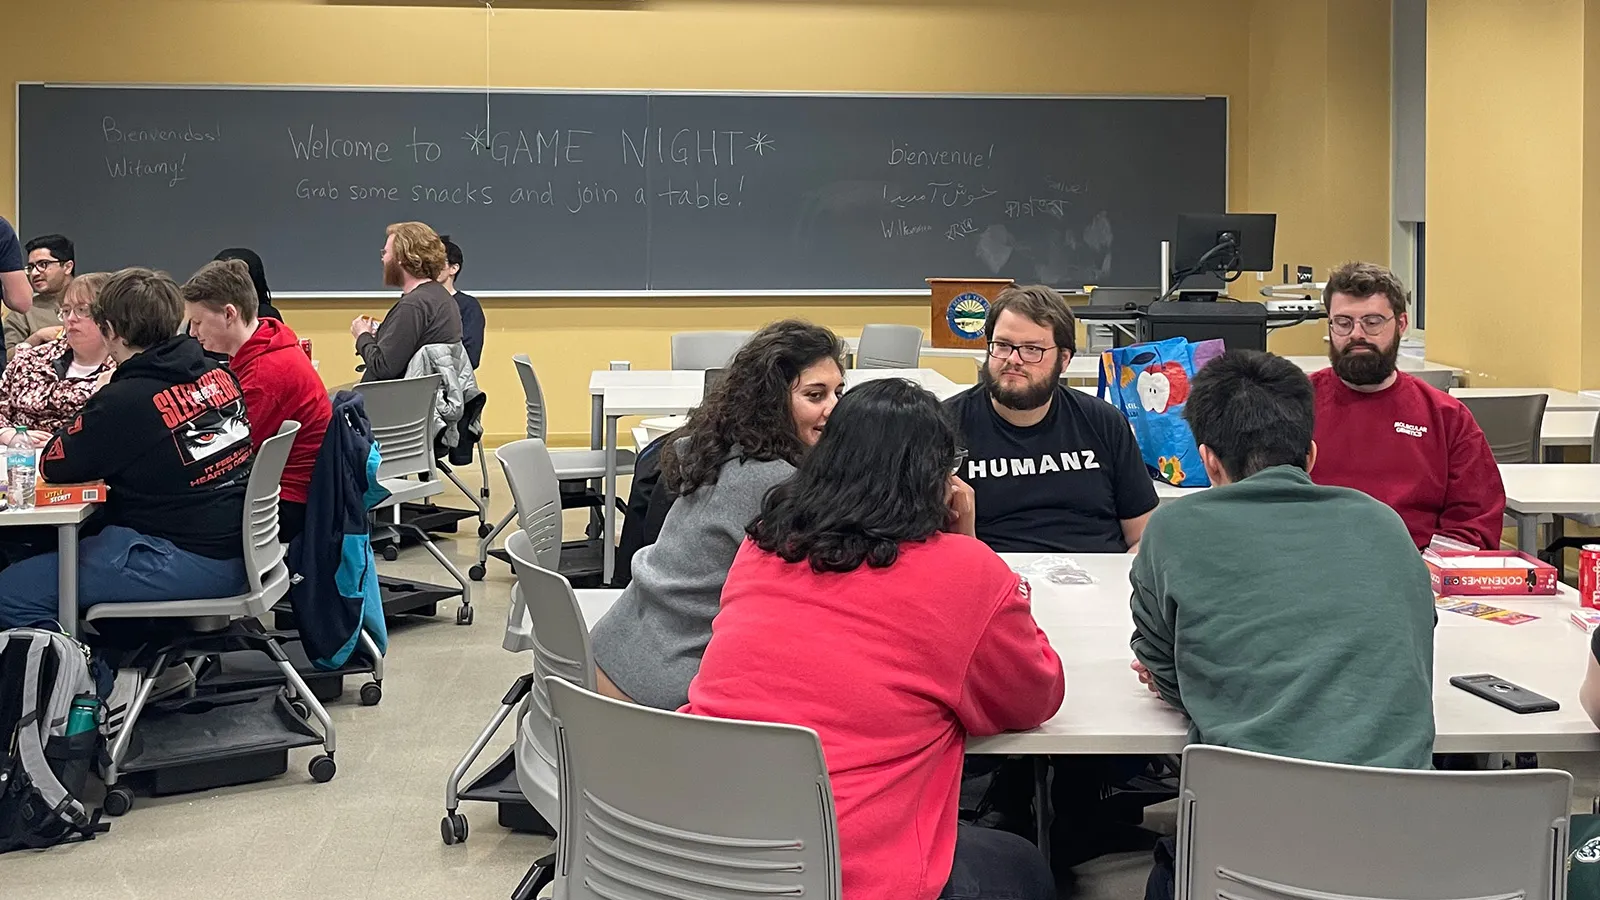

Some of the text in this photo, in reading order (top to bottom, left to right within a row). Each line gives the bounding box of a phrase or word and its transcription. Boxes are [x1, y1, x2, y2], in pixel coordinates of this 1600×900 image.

[102, 115, 221, 142] Bienvenidos!
[287, 123, 393, 163] Welcome
[405, 126, 442, 164] to
[887, 139, 994, 169] bienvenue!
[105, 152, 187, 188] Witamy!
[296, 174, 745, 214] Grab some snacks and join a table!
[967, 449, 1101, 480] HUMANZ
[1461, 575, 1523, 586] CODENAMES
